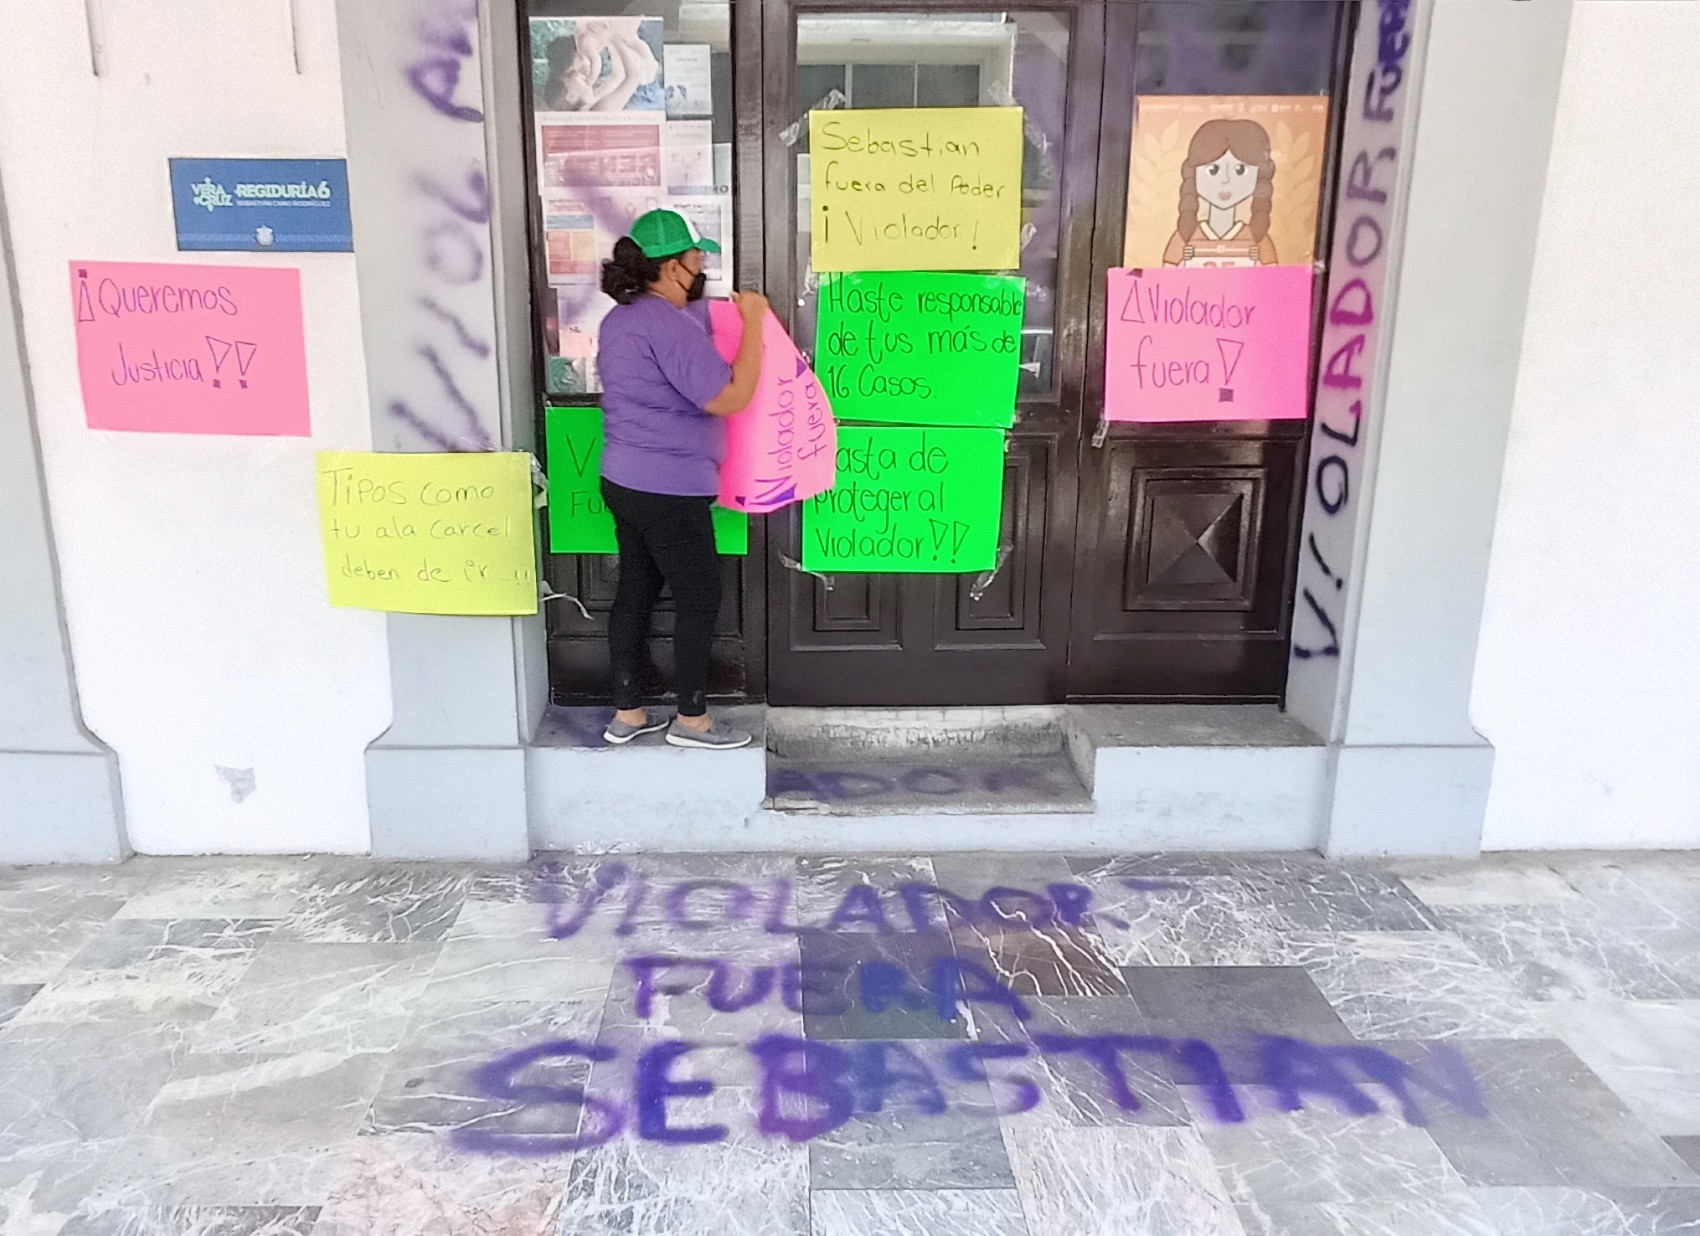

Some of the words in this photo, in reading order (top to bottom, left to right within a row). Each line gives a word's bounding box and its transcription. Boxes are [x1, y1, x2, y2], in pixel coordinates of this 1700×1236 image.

[821, 121, 980, 157] Sebastian
[899, 173, 936, 194] del
[917, 288, 1023, 323] responsable
[828, 321, 859, 357] de
[867, 320, 914, 364] tus
[928, 325, 987, 354] más
[991, 329, 1018, 353] de
[828, 365, 850, 399] 16
[835, 436, 897, 481] asta
[909, 431, 950, 474] de
[918, 481, 944, 512] al
[332, 517, 361, 539] tu
[341, 554, 400, 581] deben
[417, 558, 450, 583] de
[450, 1033, 1491, 1156] SEBASTIAN
